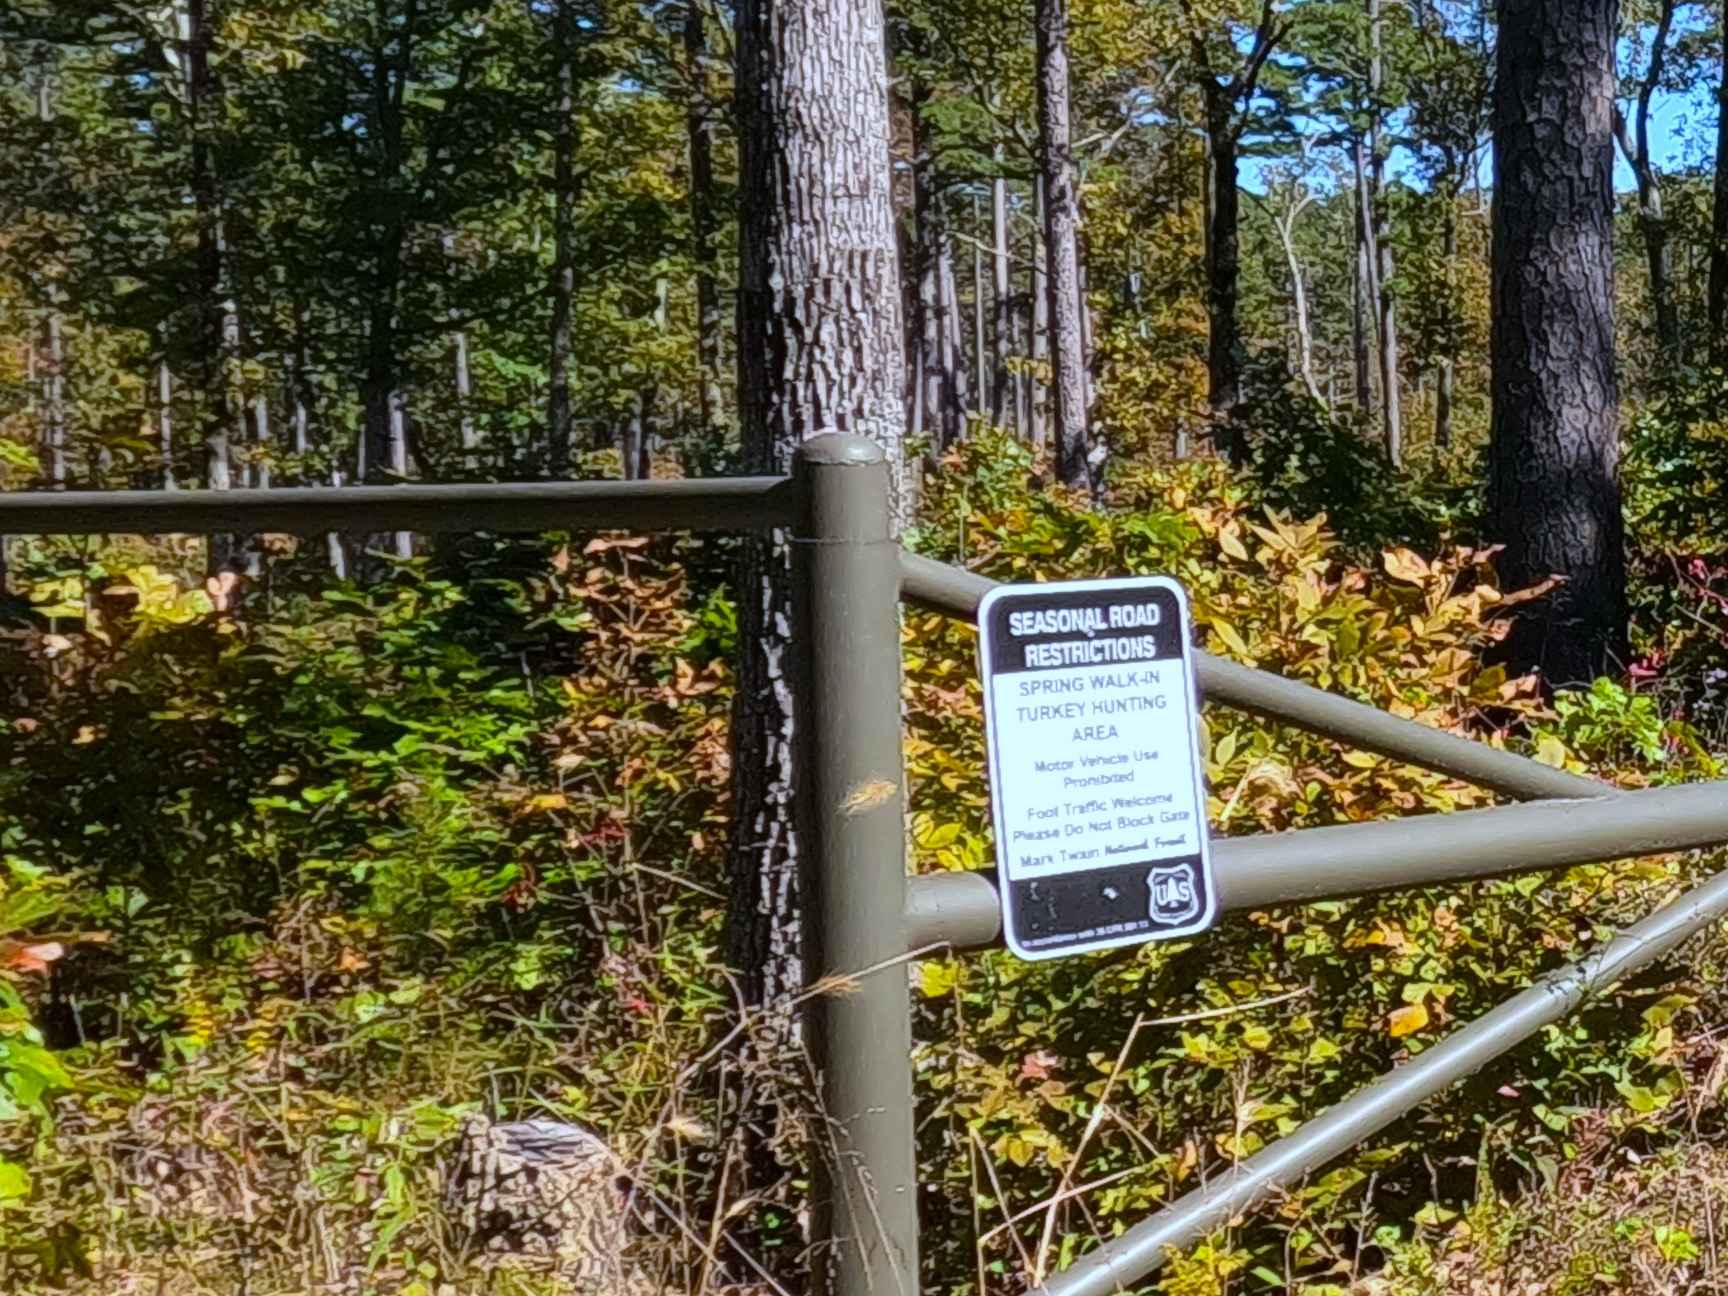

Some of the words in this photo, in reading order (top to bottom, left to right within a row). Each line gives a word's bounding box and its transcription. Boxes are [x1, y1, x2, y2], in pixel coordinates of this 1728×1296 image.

[1009, 608, 1108, 636] SEASONAL
[1109, 603, 1160, 628] ROAD
[1024, 635, 1156, 667] RESTRICTIONS
[1019, 677, 1085, 696] SPRING
[1090, 670, 1160, 689] WALK-IN
[1016, 702, 1086, 722] TURKEY
[1092, 694, 1167, 714] HUNTING
[1072, 725, 1119, 742] AREA
[1035, 761, 1074, 772] Motor
[1079, 754, 1129, 768] Vehicle
[1133, 750, 1159, 762] Use
[1064, 769, 1134, 788] Prohibited
[1027, 806, 1059, 820] Foot
[1064, 800, 1107, 816] Traffic
[1112, 793, 1173, 809] Welcome
[1013, 828, 1060, 842] Please
[1065, 823, 1084, 837] Do
[1090, 820, 1113, 832] Not
[1118, 813, 1154, 828] Block
[1159, 810, 1190, 823] Gate
